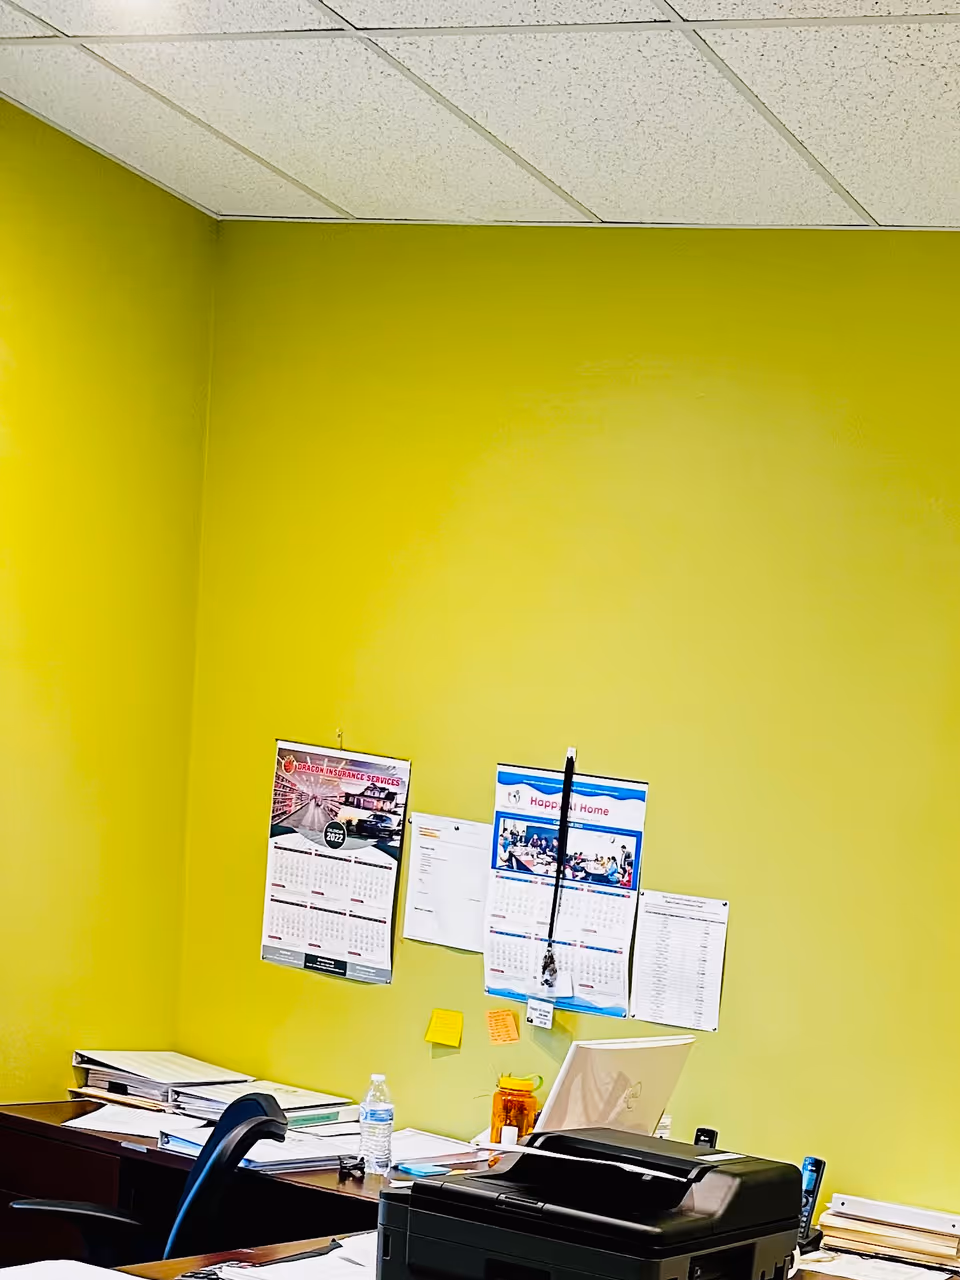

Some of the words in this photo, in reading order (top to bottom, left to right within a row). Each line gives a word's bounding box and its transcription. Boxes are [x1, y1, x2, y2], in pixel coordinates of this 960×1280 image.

[297, 763, 324, 774] DRAGON
[325, 769, 364, 781] INSURANCE
[366, 774, 401, 787] SERVICES
[580, 804, 609, 816] Home
[326, 832, 343, 843] 2022
